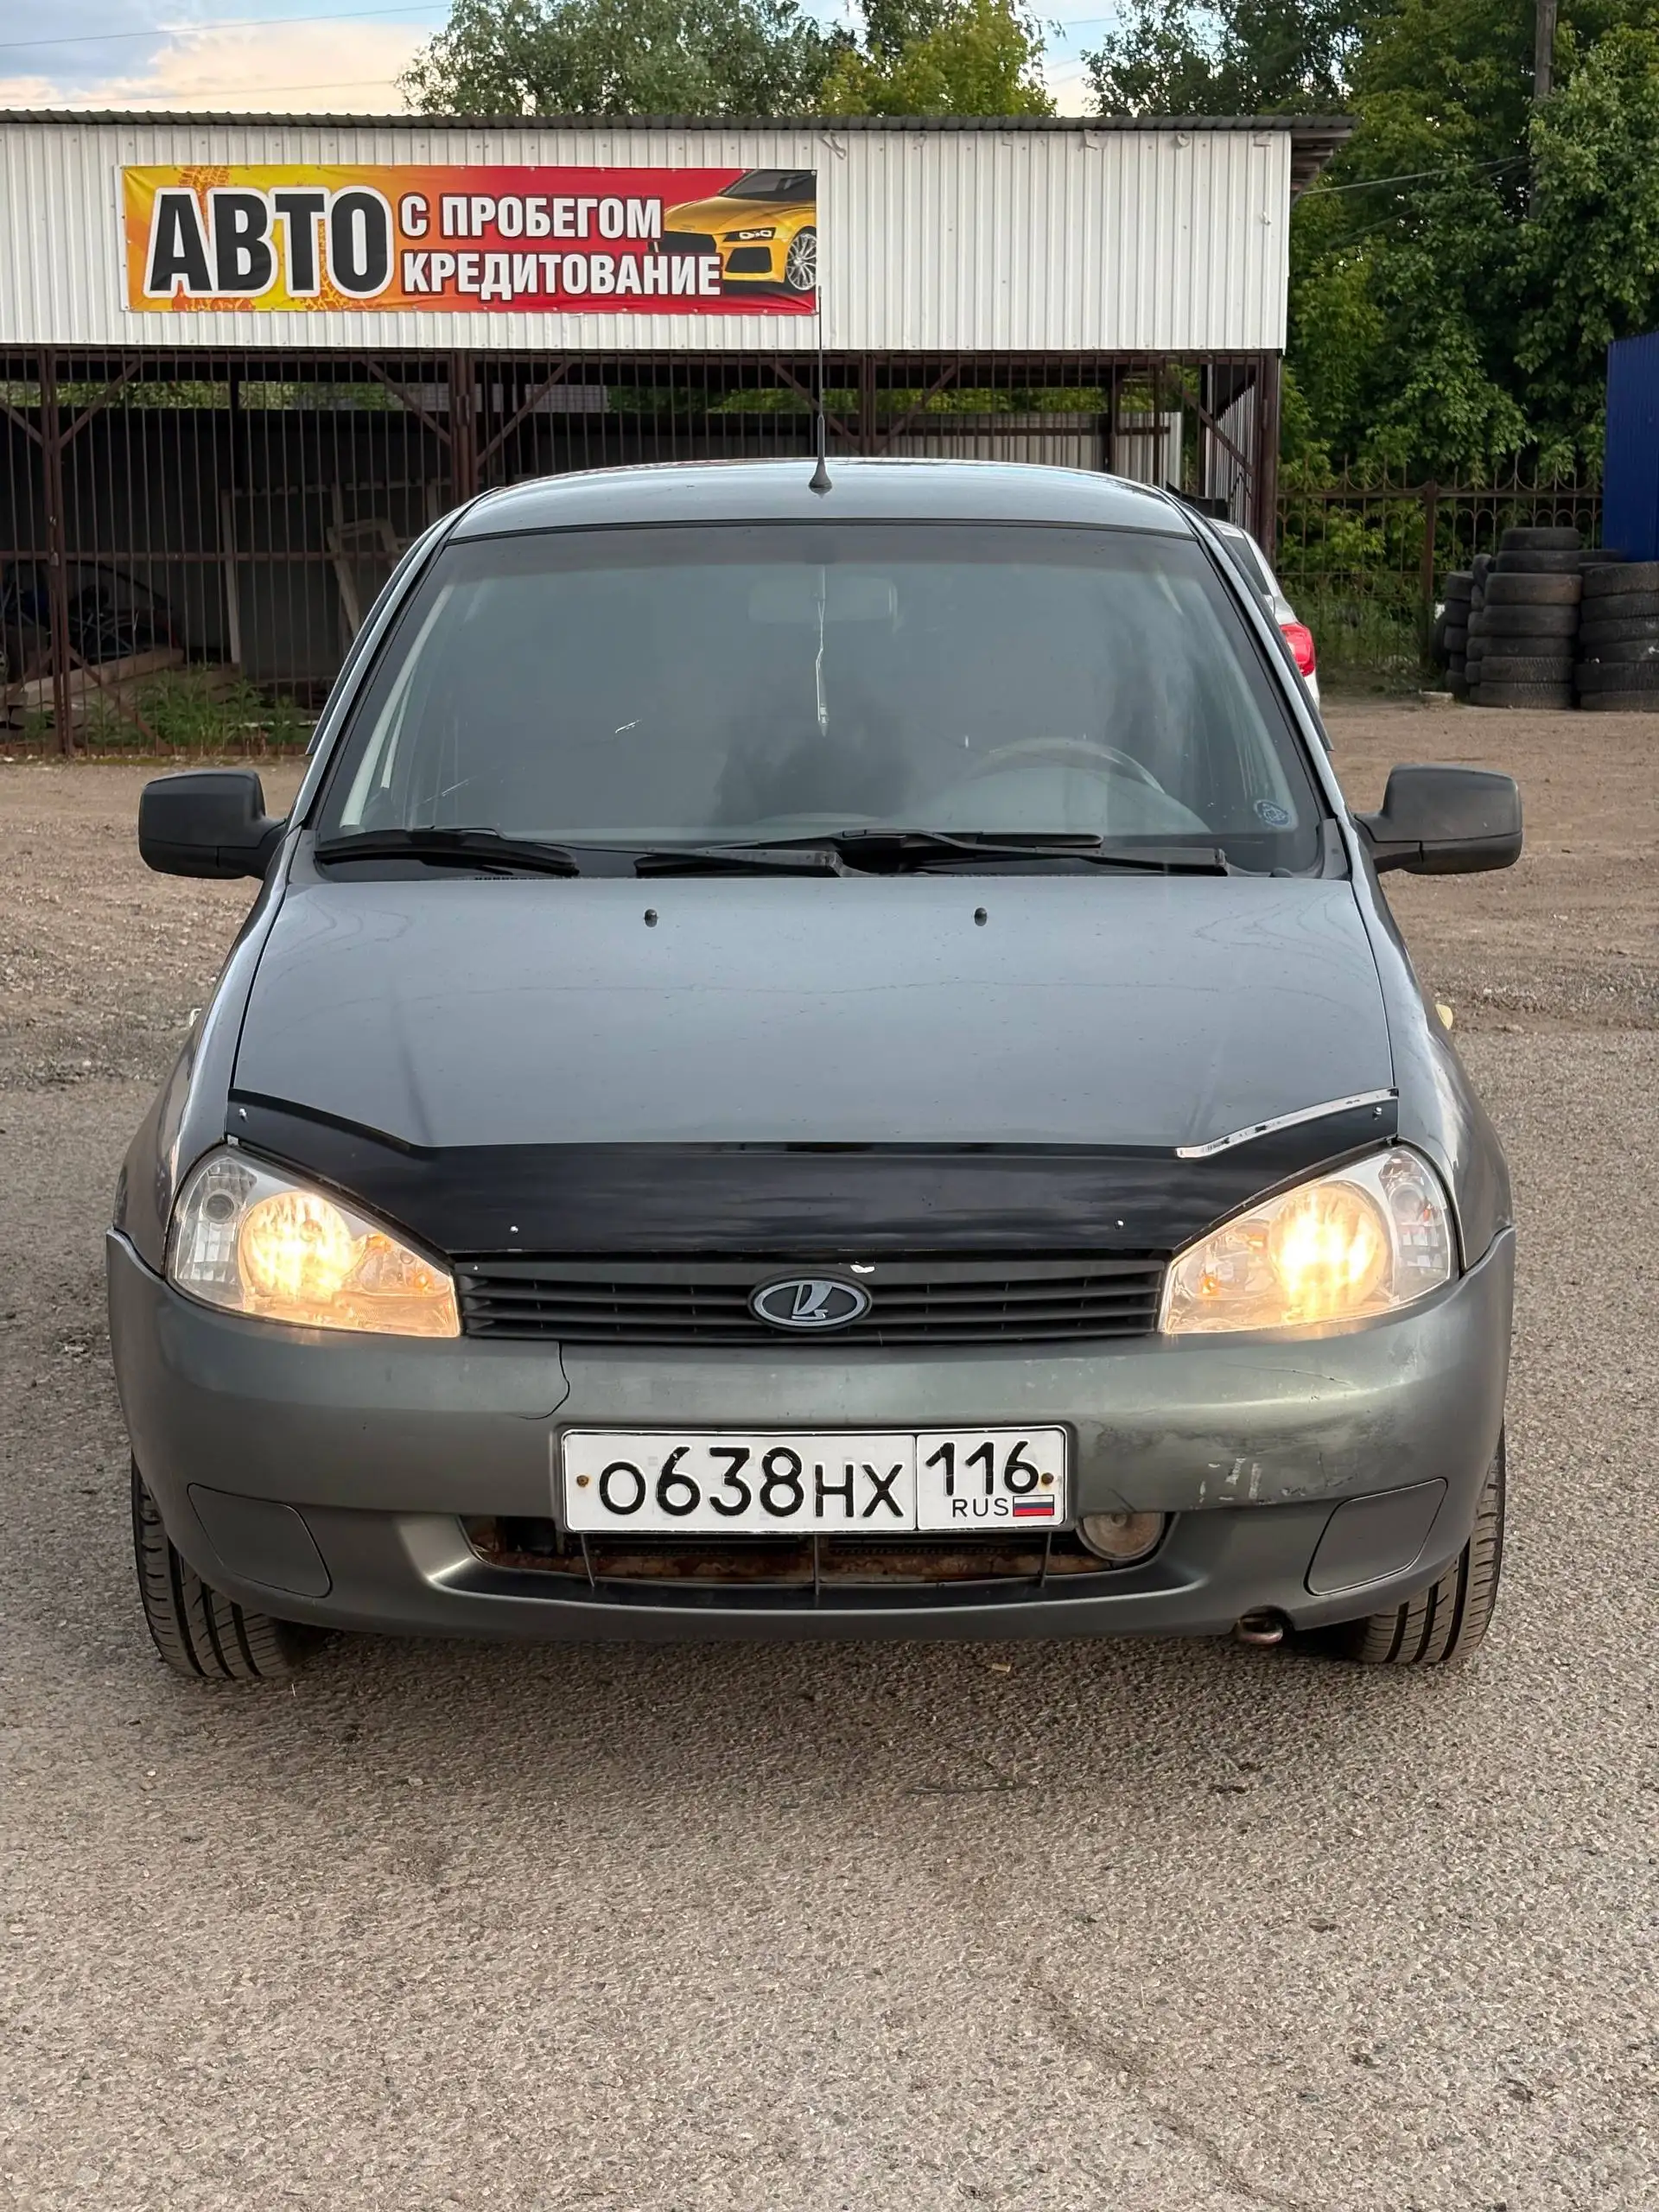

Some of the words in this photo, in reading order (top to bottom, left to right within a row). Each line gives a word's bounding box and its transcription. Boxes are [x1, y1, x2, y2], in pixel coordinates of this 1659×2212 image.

[402, 195, 427, 238] С
[443, 196, 661, 239] ПРОБЕГОМ
[147, 192, 389, 292] АВТО
[404, 254, 721, 301] КРЕДИТОВАНИЕ
[925, 1440, 1039, 1497] 116
[952, 1497, 1009, 1518] RUS
